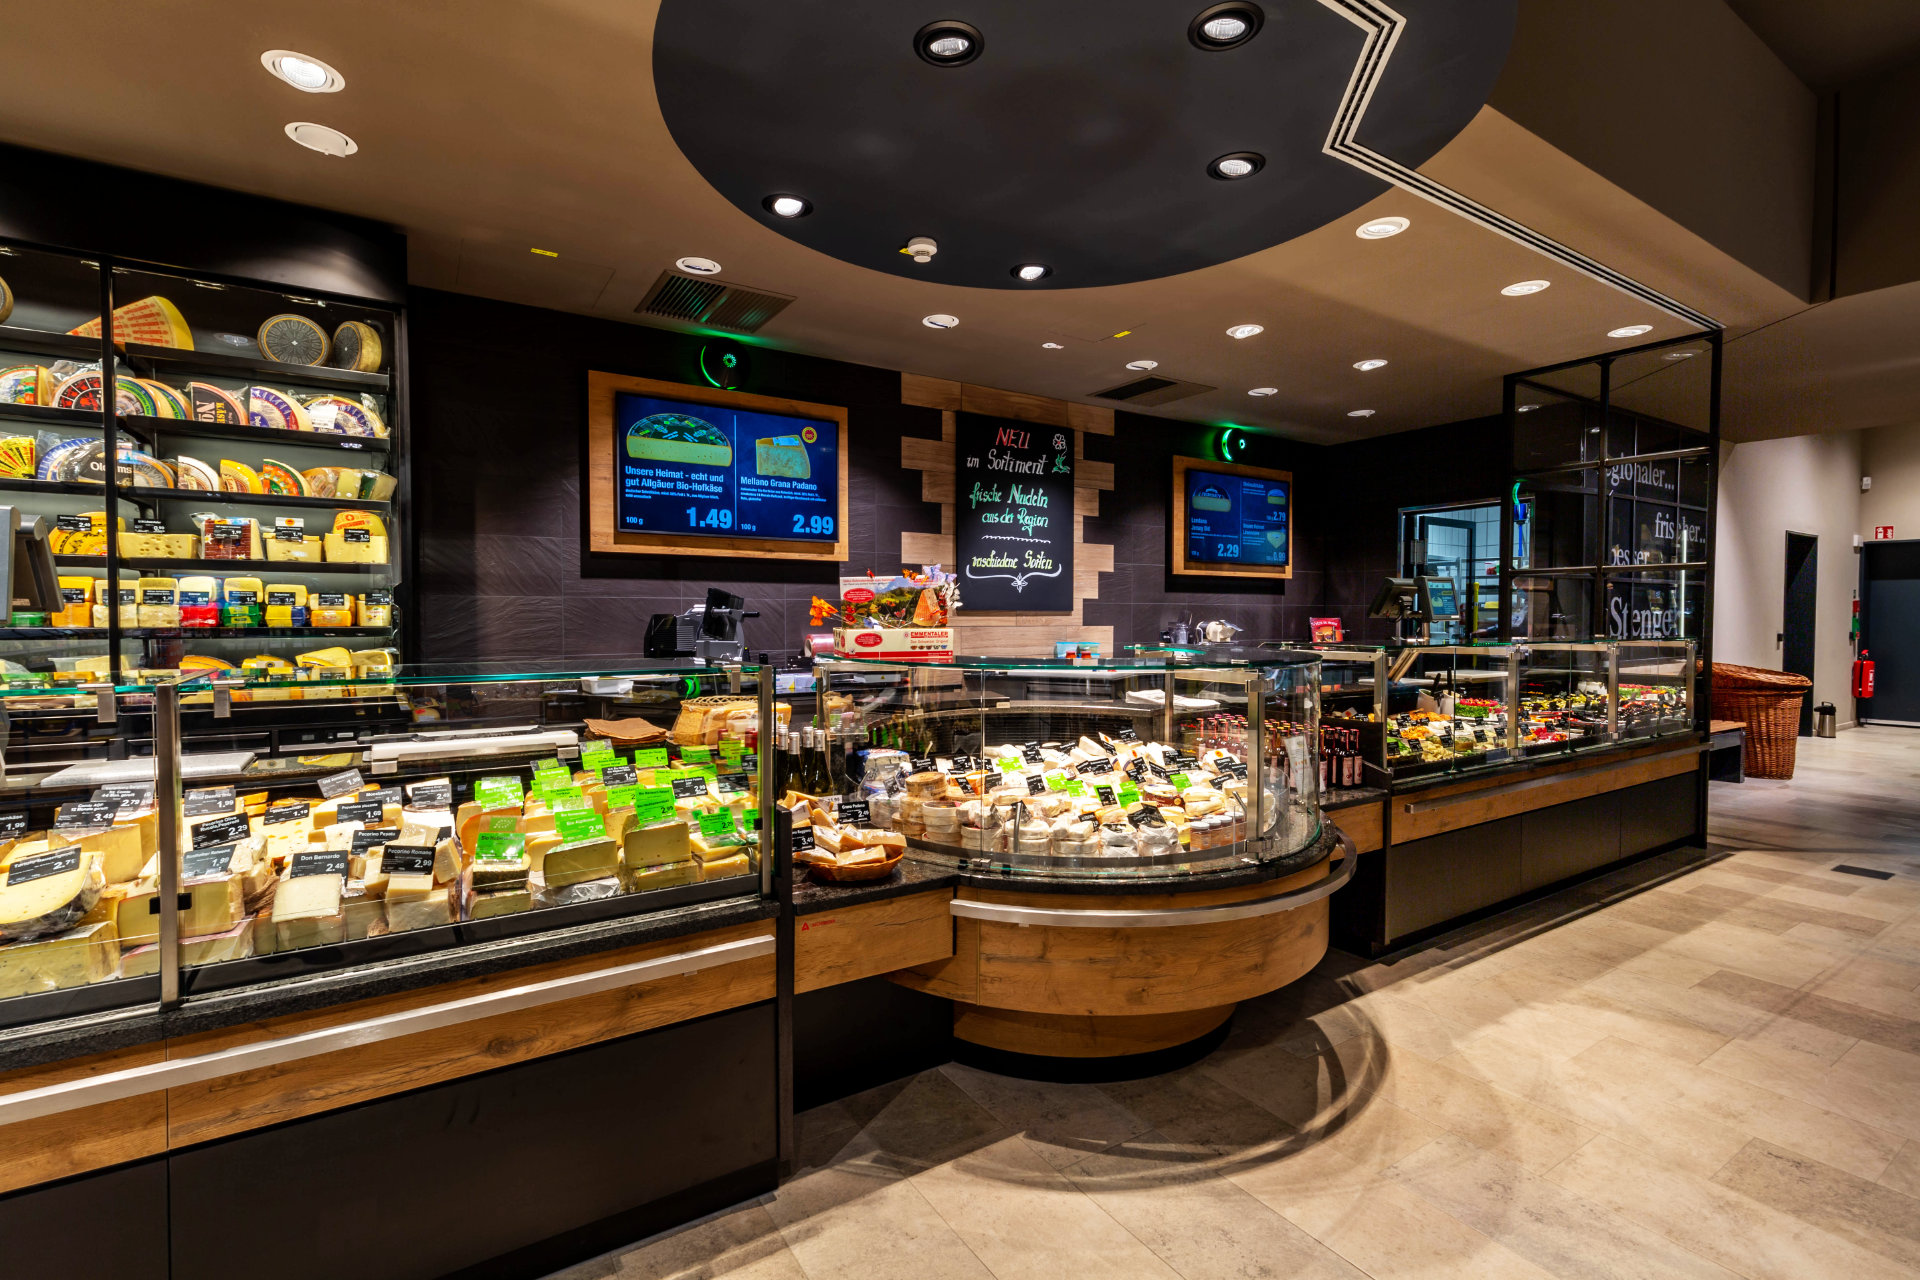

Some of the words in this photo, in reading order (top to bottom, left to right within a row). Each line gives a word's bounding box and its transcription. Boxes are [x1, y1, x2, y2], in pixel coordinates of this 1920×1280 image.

[995, 426, 1031, 449] NEU
[966, 455, 980, 468] im
[987, 448, 1049, 475] Sortiment
[117, 465, 133, 475] ms
[625, 465, 654, 477] Unsere
[655, 468, 684, 479] Heimat
[690, 472, 708, 481] echt
[709, 474, 724, 482] und
[1606, 452, 1675, 491] gionaler...
[625, 478, 640, 487] gut
[641, 478, 675, 489] Allgäuer
[676, 481, 723, 493] Bio-Hofkäse
[740, 476, 769, 487] Mellano
[770, 478, 791, 489] Grana
[792, 481, 818, 491] Padano
[969, 481, 1002, 510] frische
[1006, 483, 1049, 509] Nudeln
[626, 516, 638, 524] 100
[686, 506, 733, 529] 1.49
[792, 514, 834, 535] 2.99
[981, 512, 1000, 523] aus
[1000, 507, 1014, 524] der
[1016, 507, 1049, 537] Region
[1217, 543, 1239, 558] 2.29
[1023, 550, 1053, 570] Sorten
[120, 799, 140, 807] 2.79
[216, 799, 234, 808] 1.99
[93, 812, 114, 822] 3.49
[5, 821, 25, 831] 1.99
[228, 824, 248, 836] 2.29
[313, 853, 340, 861] Bernardo
[411, 848, 433, 856] Romano
[325, 862, 345, 872] 2.49
[414, 859, 433, 869] 2.99
